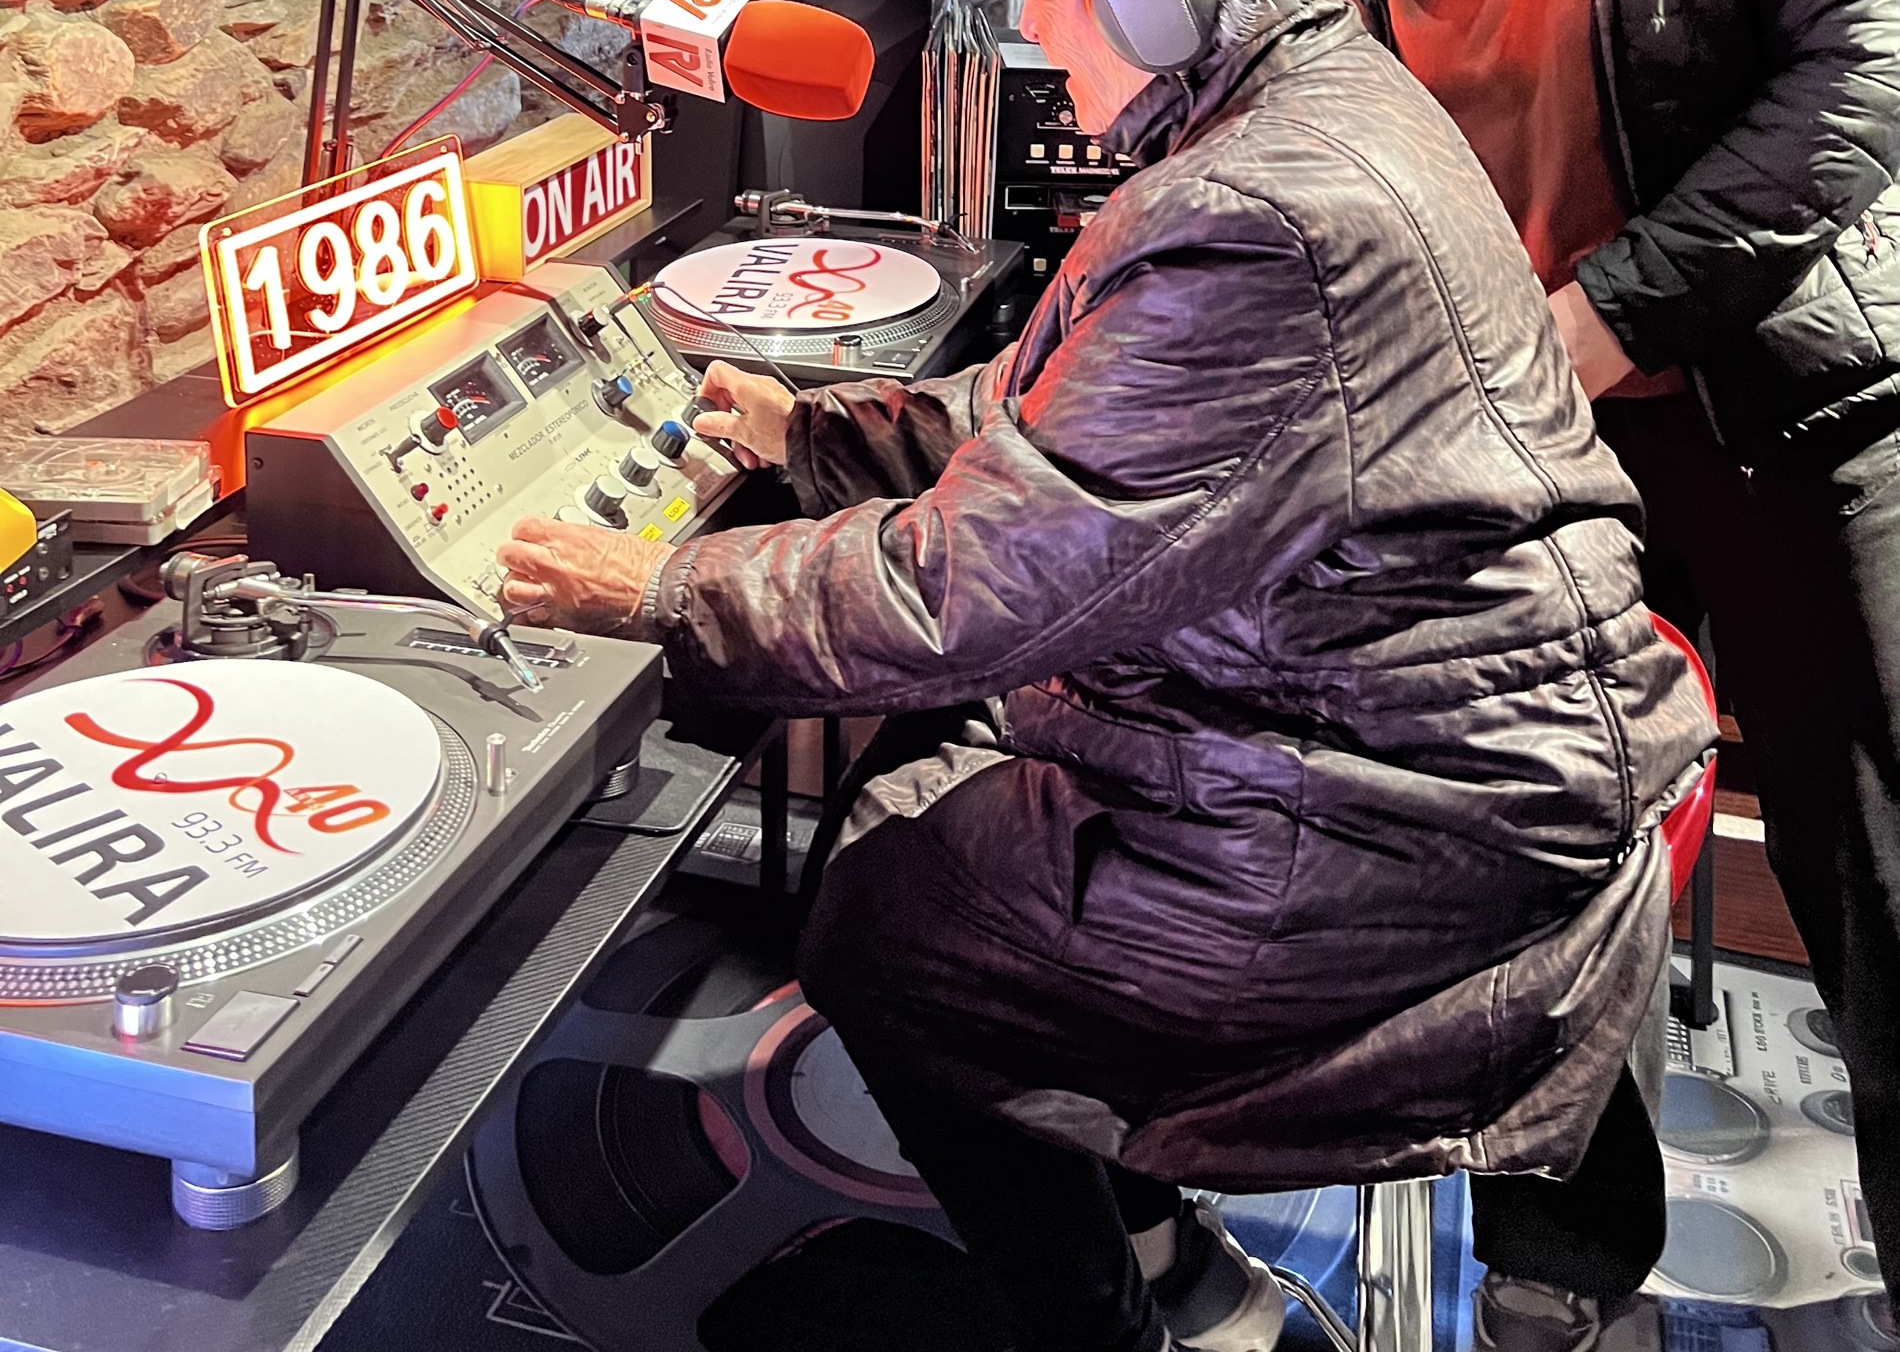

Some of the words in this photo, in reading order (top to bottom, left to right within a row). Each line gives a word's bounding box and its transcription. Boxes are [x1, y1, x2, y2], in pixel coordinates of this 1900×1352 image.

[524, 166, 573, 258] ON
[582, 141, 636, 226] AIR
[246, 179, 456, 349] 1986
[707, 243, 800, 315] VALIRA
[812, 299, 854, 321] 40
[509, 431, 545, 461] MEZCLADOR
[545, 399, 589, 435] ESTEREOFONICO
[283, 784, 391, 834] 40
[171, 811, 243, 854] 93.3
[224, 852, 270, 879] FM
